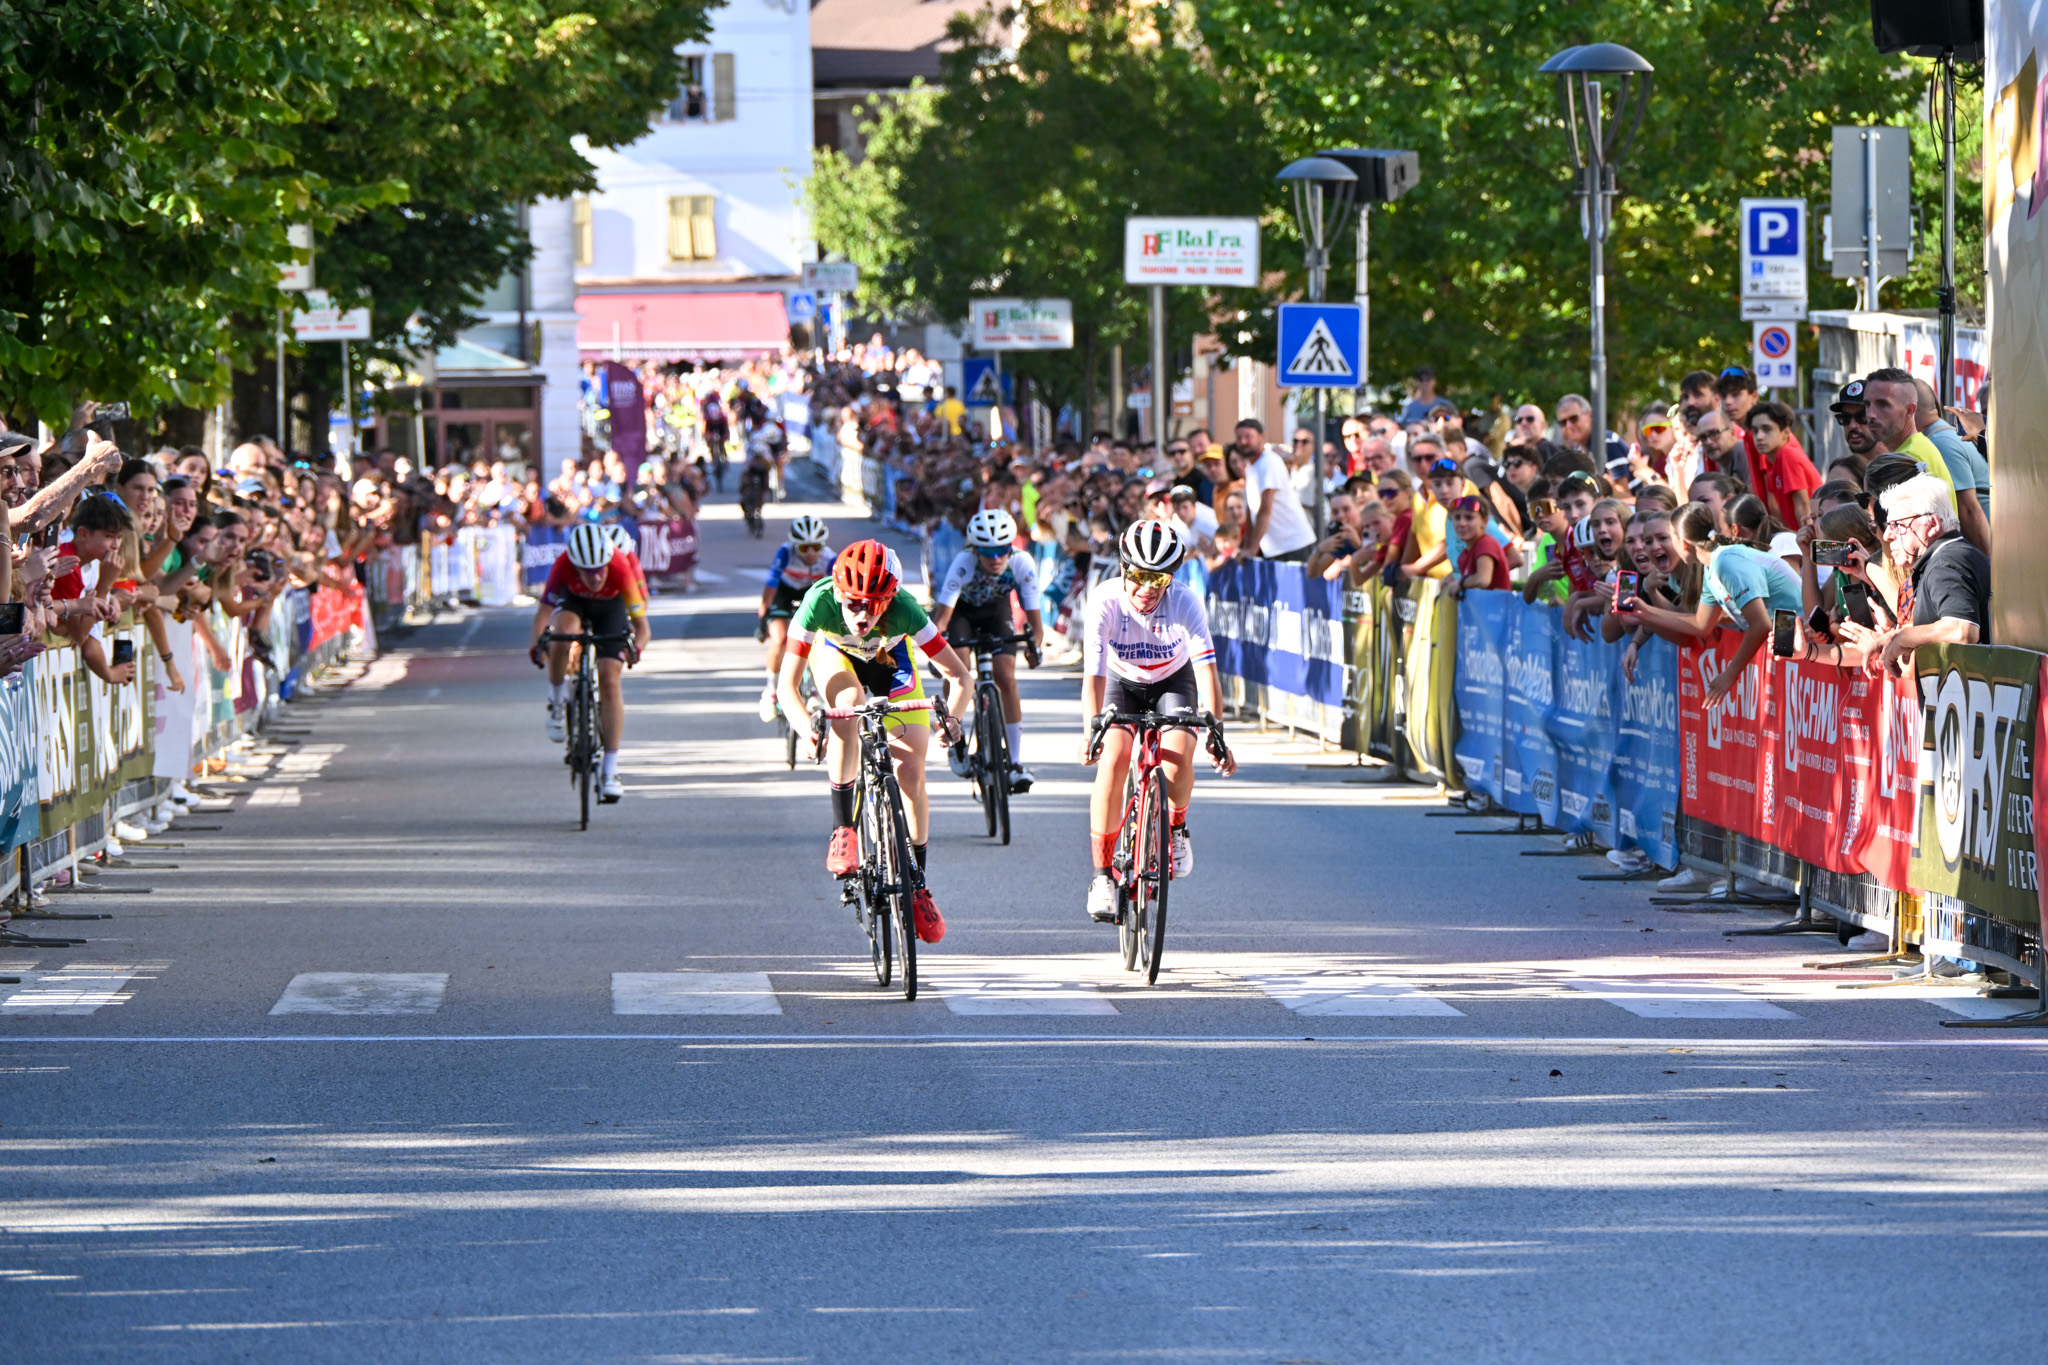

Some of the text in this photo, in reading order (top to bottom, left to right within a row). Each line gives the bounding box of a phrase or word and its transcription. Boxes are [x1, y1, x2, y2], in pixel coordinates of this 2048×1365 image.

[1758, 212, 1789, 252] P
[1109, 639, 1144, 651] CAMPIONE
[1118, 650, 1175, 659] PIEMONTE
[1911, 669, 2021, 866] FORST
